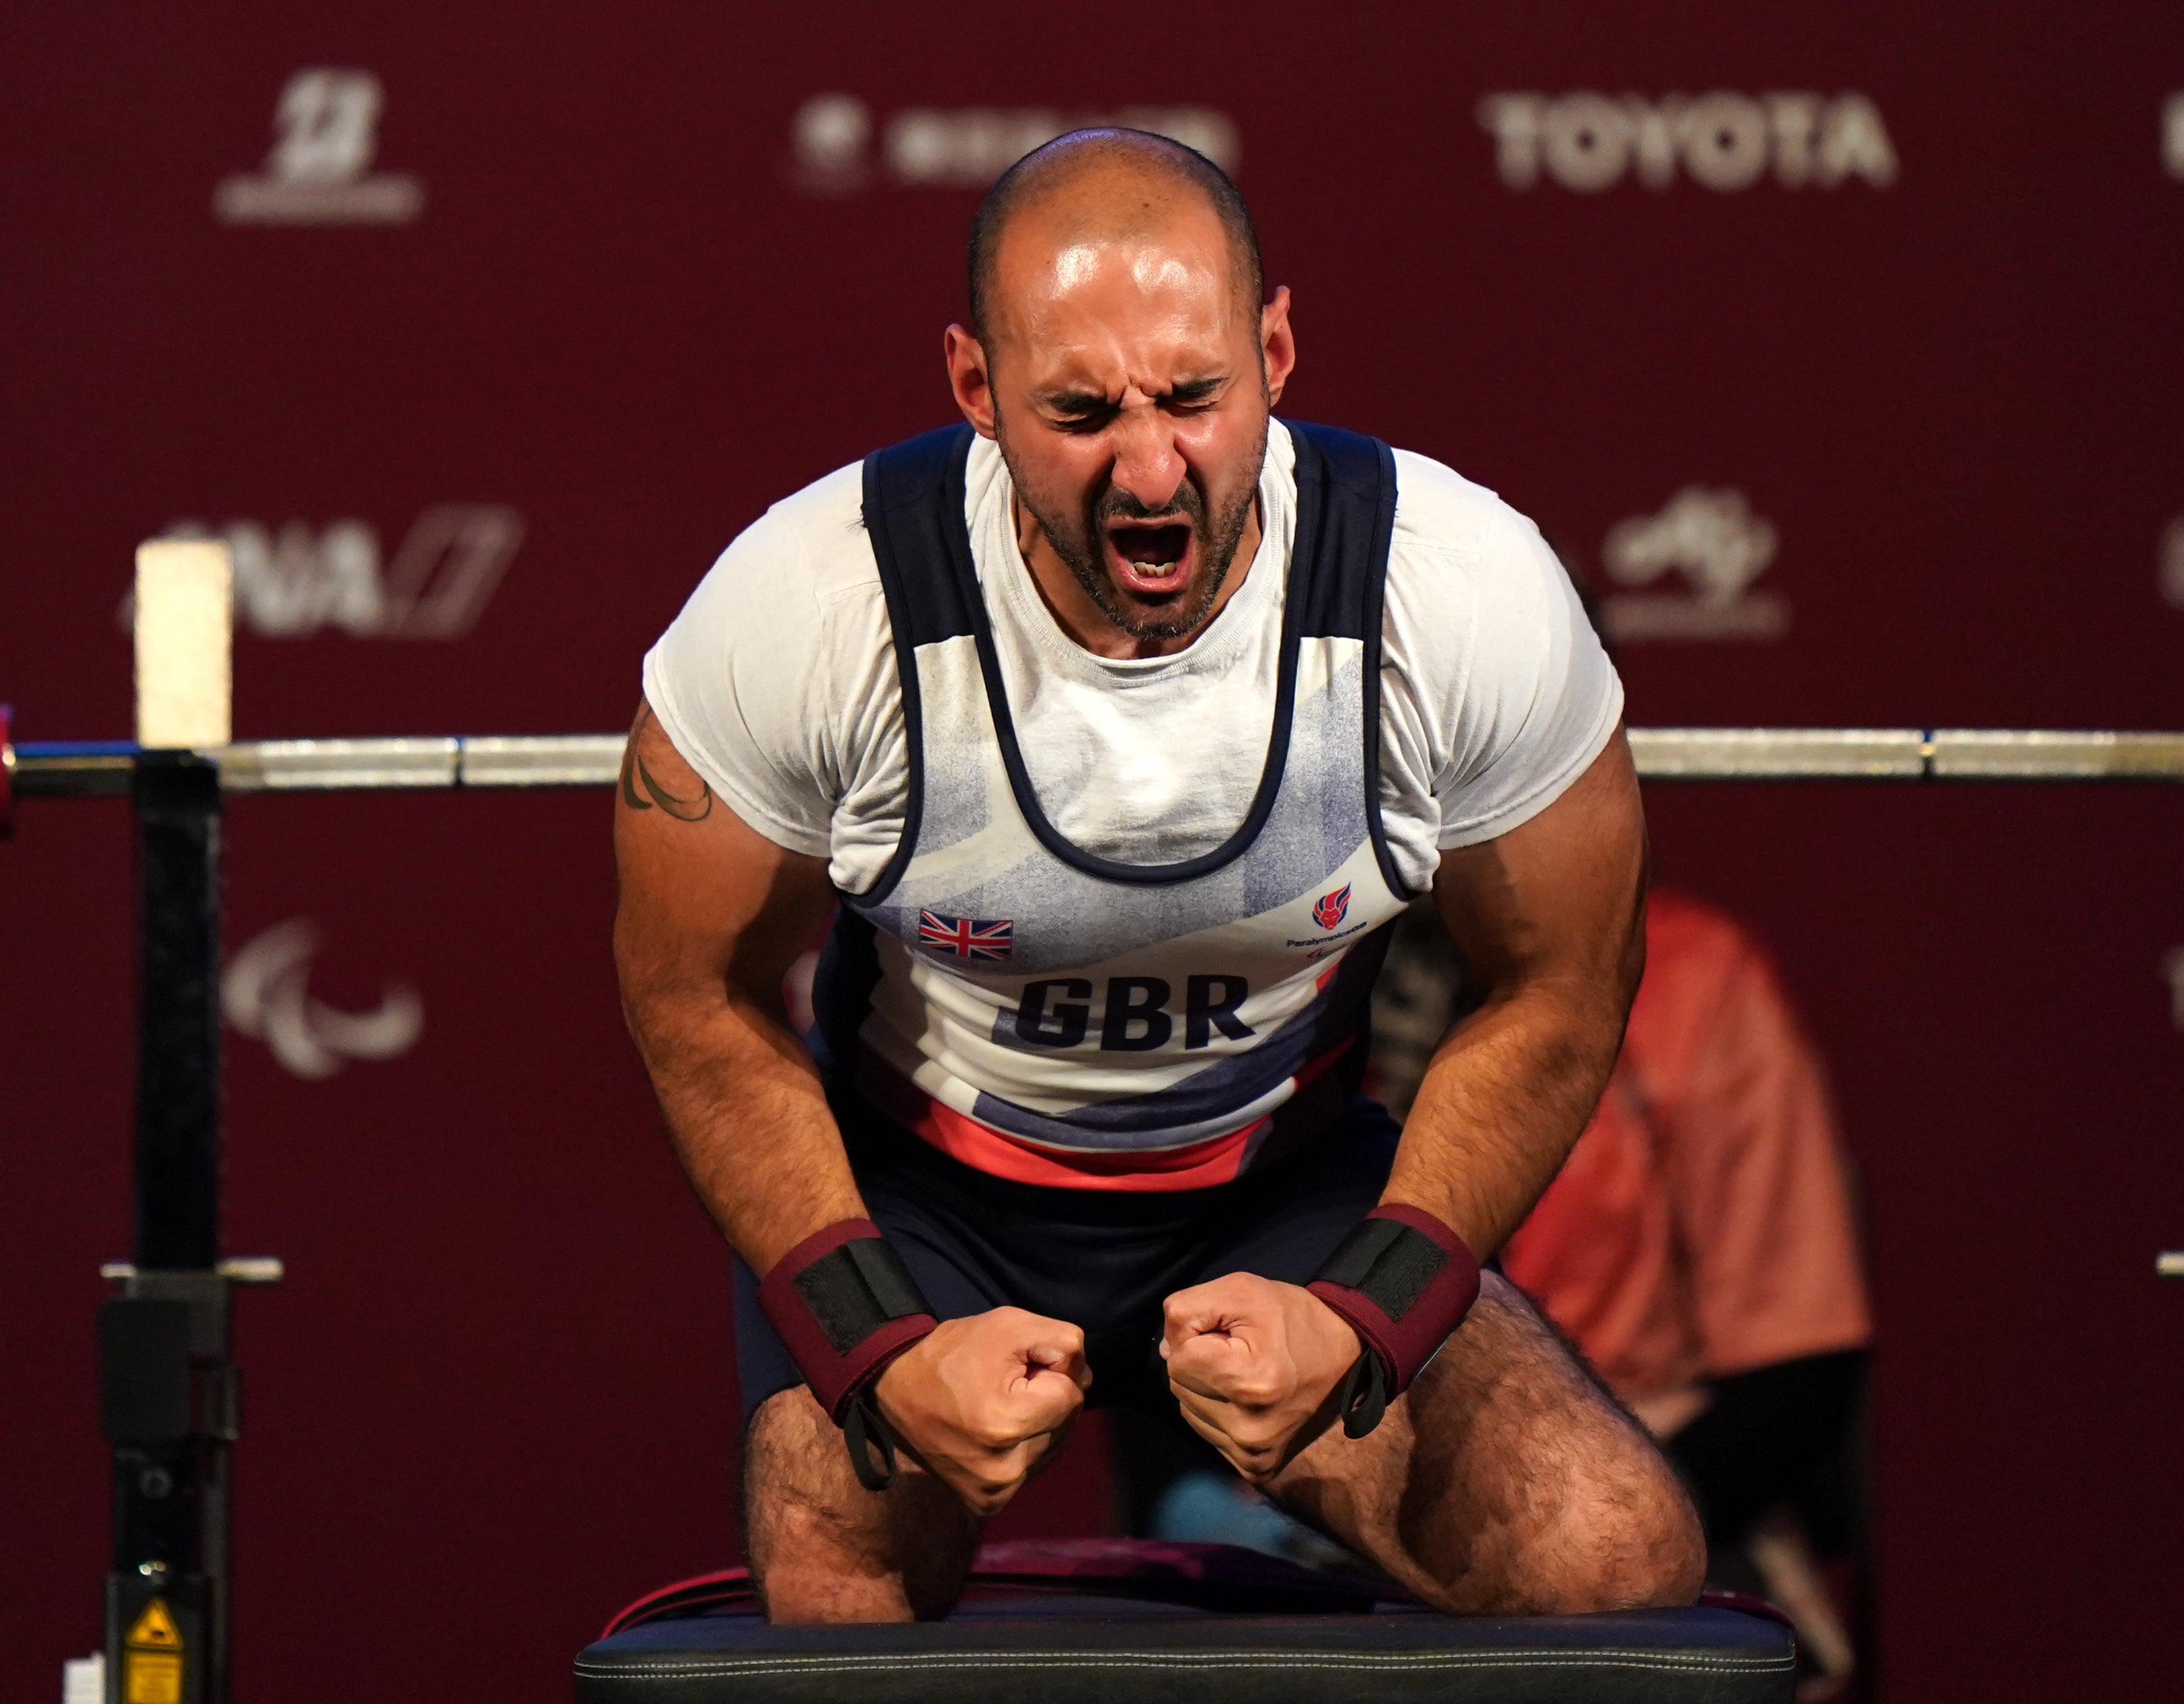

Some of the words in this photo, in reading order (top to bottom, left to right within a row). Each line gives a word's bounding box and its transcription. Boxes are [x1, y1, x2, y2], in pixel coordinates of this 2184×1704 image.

[1479, 92, 1898, 188] TOYOTA
[121, 521, 384, 636] NA
[1015, 975, 1256, 1051] GBR
